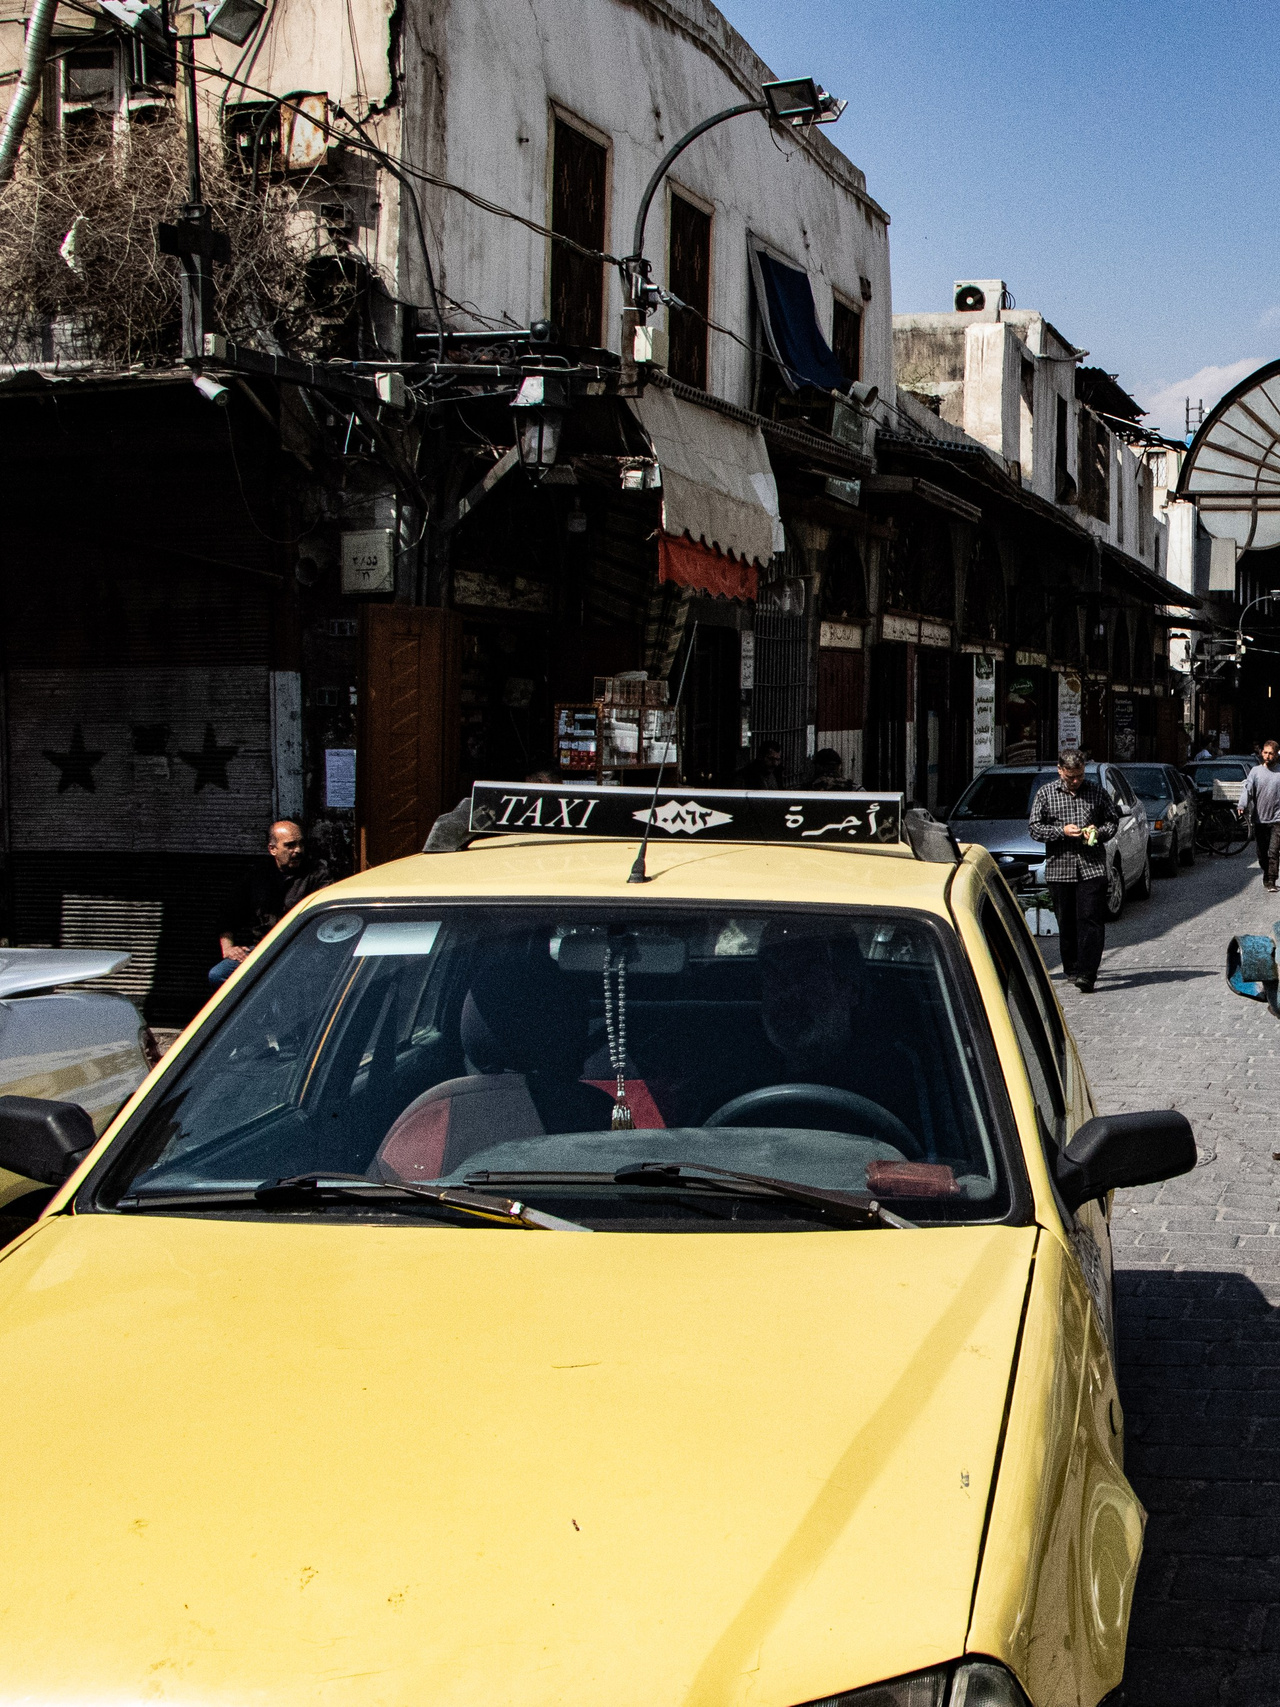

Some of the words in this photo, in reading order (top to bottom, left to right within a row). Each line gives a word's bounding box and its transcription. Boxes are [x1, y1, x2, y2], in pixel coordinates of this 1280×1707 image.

[496, 795, 600, 829] TAXI
[651, 808, 713, 827] ١٠٨٦٣
[785, 803, 881, 836] أجرة
